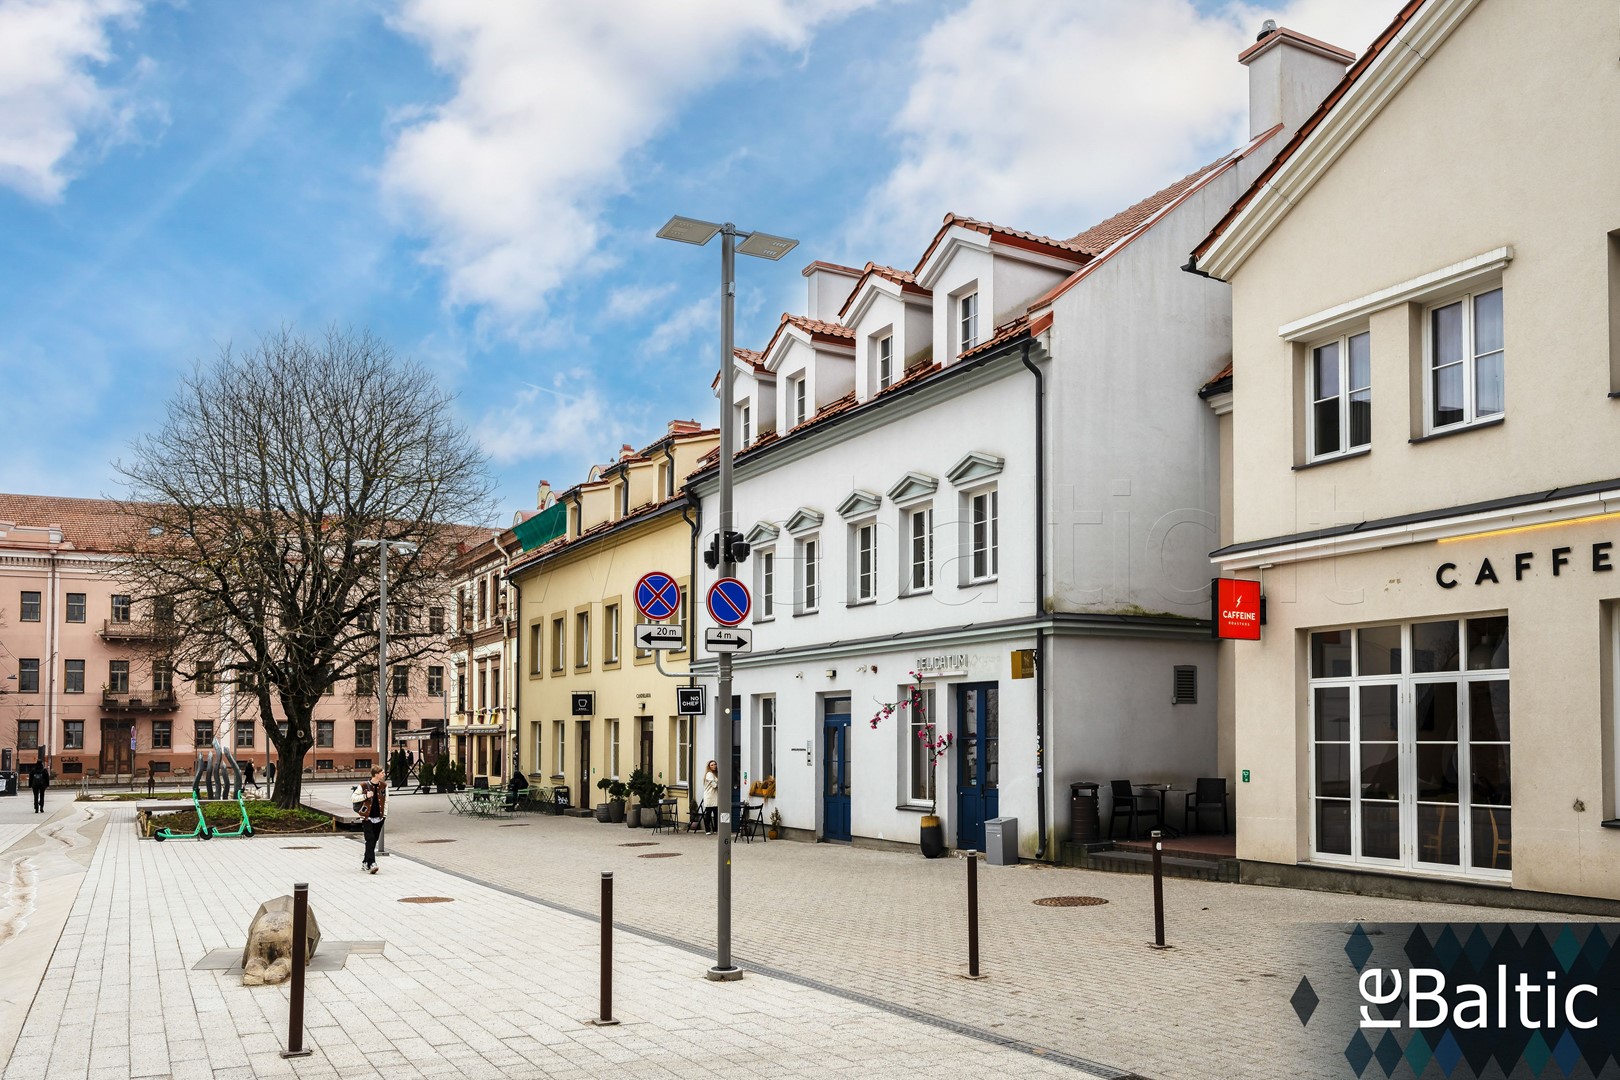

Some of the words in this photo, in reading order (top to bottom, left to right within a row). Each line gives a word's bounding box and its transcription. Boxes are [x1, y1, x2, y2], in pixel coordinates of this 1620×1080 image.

[1436, 542, 1613, 589] CAFFE
[1222, 610, 1256, 621] CAFFEINE
[657, 627, 667, 635] 20
[716, 631, 722, 639] 4
